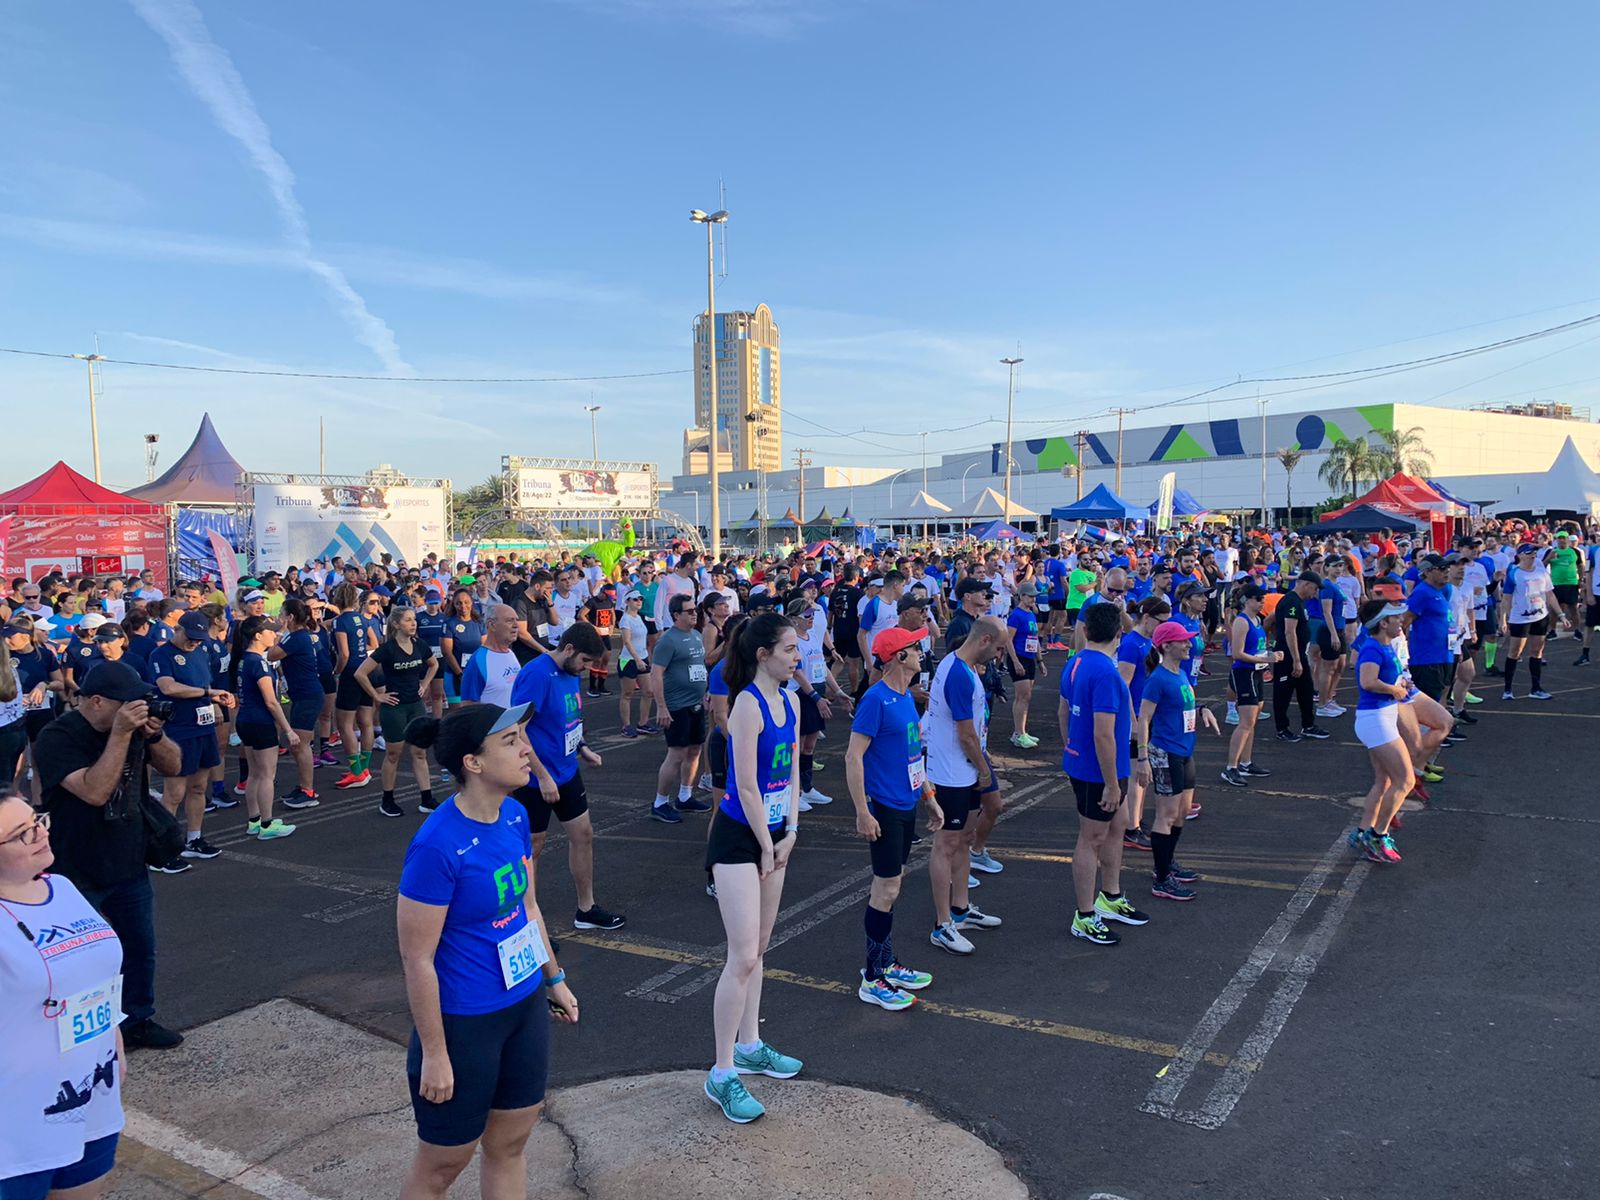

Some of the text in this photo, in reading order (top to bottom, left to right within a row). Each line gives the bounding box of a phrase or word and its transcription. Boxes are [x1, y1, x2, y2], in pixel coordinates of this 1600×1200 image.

[522, 479, 552, 489] Tribuna
[275, 496, 313, 506] Tribuna
[70, 918, 96, 930] MEIA
[44, 937, 85, 956] TRIBUNA
[509, 944, 535, 975] 5190
[73, 1001, 111, 1036] 5166
